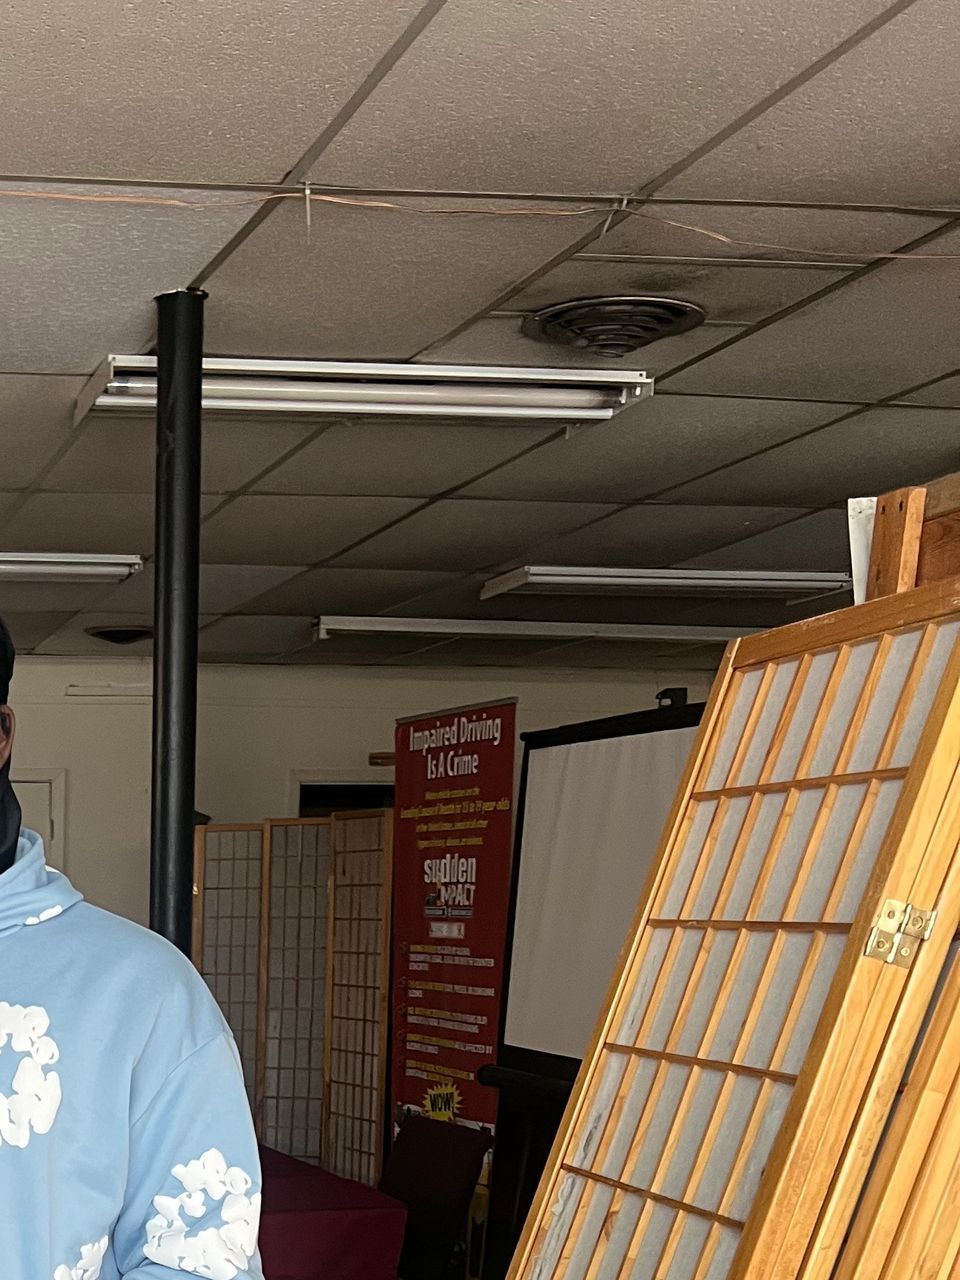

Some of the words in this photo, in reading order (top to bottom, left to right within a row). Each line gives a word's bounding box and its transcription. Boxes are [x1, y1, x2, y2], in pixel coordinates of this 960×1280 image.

[409, 718, 457, 755] Impaired
[460, 713, 502, 746] Driving
[427, 754, 437, 780] Is
[437, 751, 445, 778] A
[447, 748, 479, 777] Crime
[424, 853, 476, 882] sudden
[428, 1092, 454, 1113] WOW!
